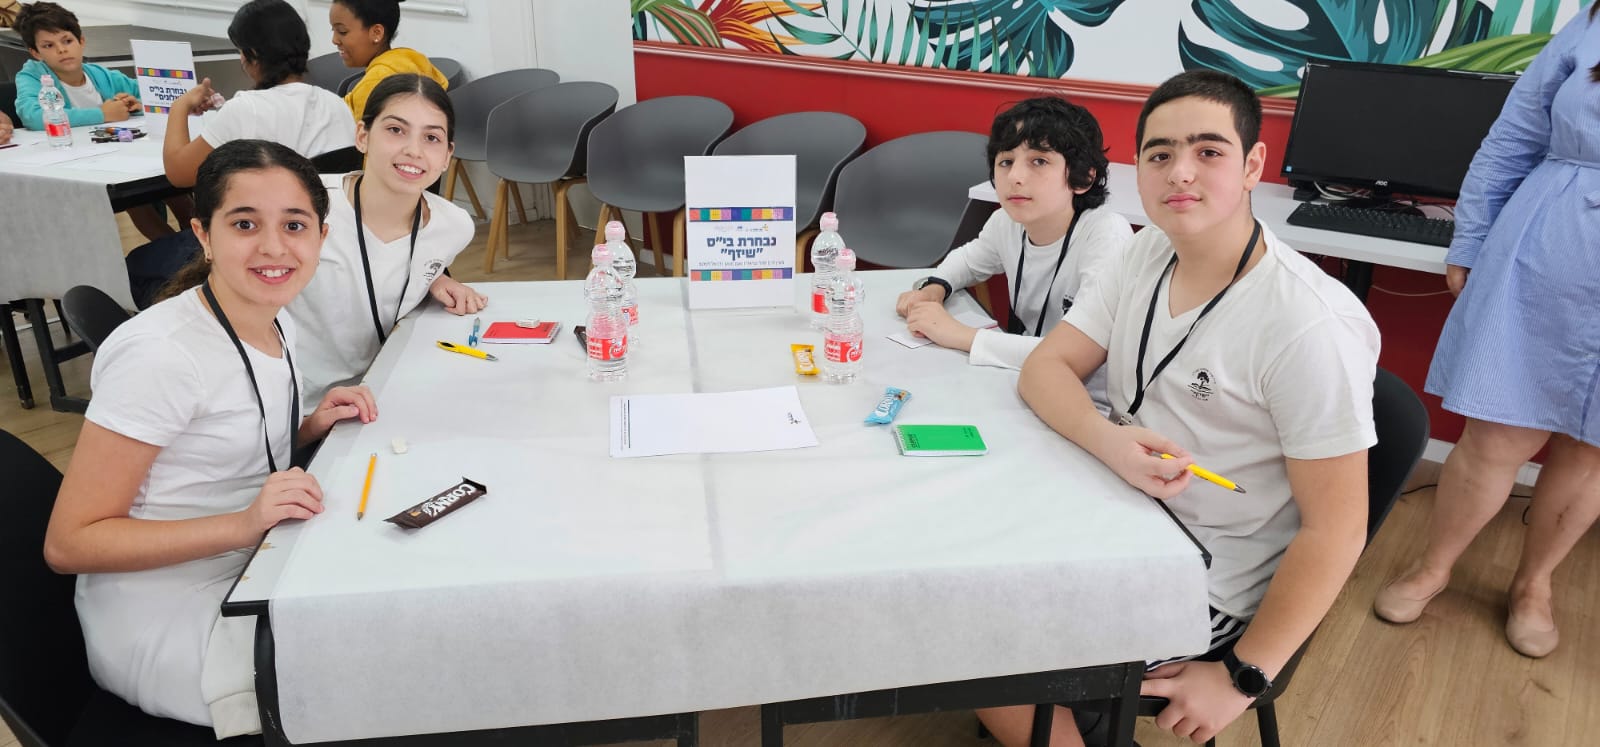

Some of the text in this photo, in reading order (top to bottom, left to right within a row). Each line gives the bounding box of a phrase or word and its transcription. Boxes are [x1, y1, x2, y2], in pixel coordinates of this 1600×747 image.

[706, 236, 777, 247] נבחרת בי"ס
[720, 247, 764, 261] "שיזף"
